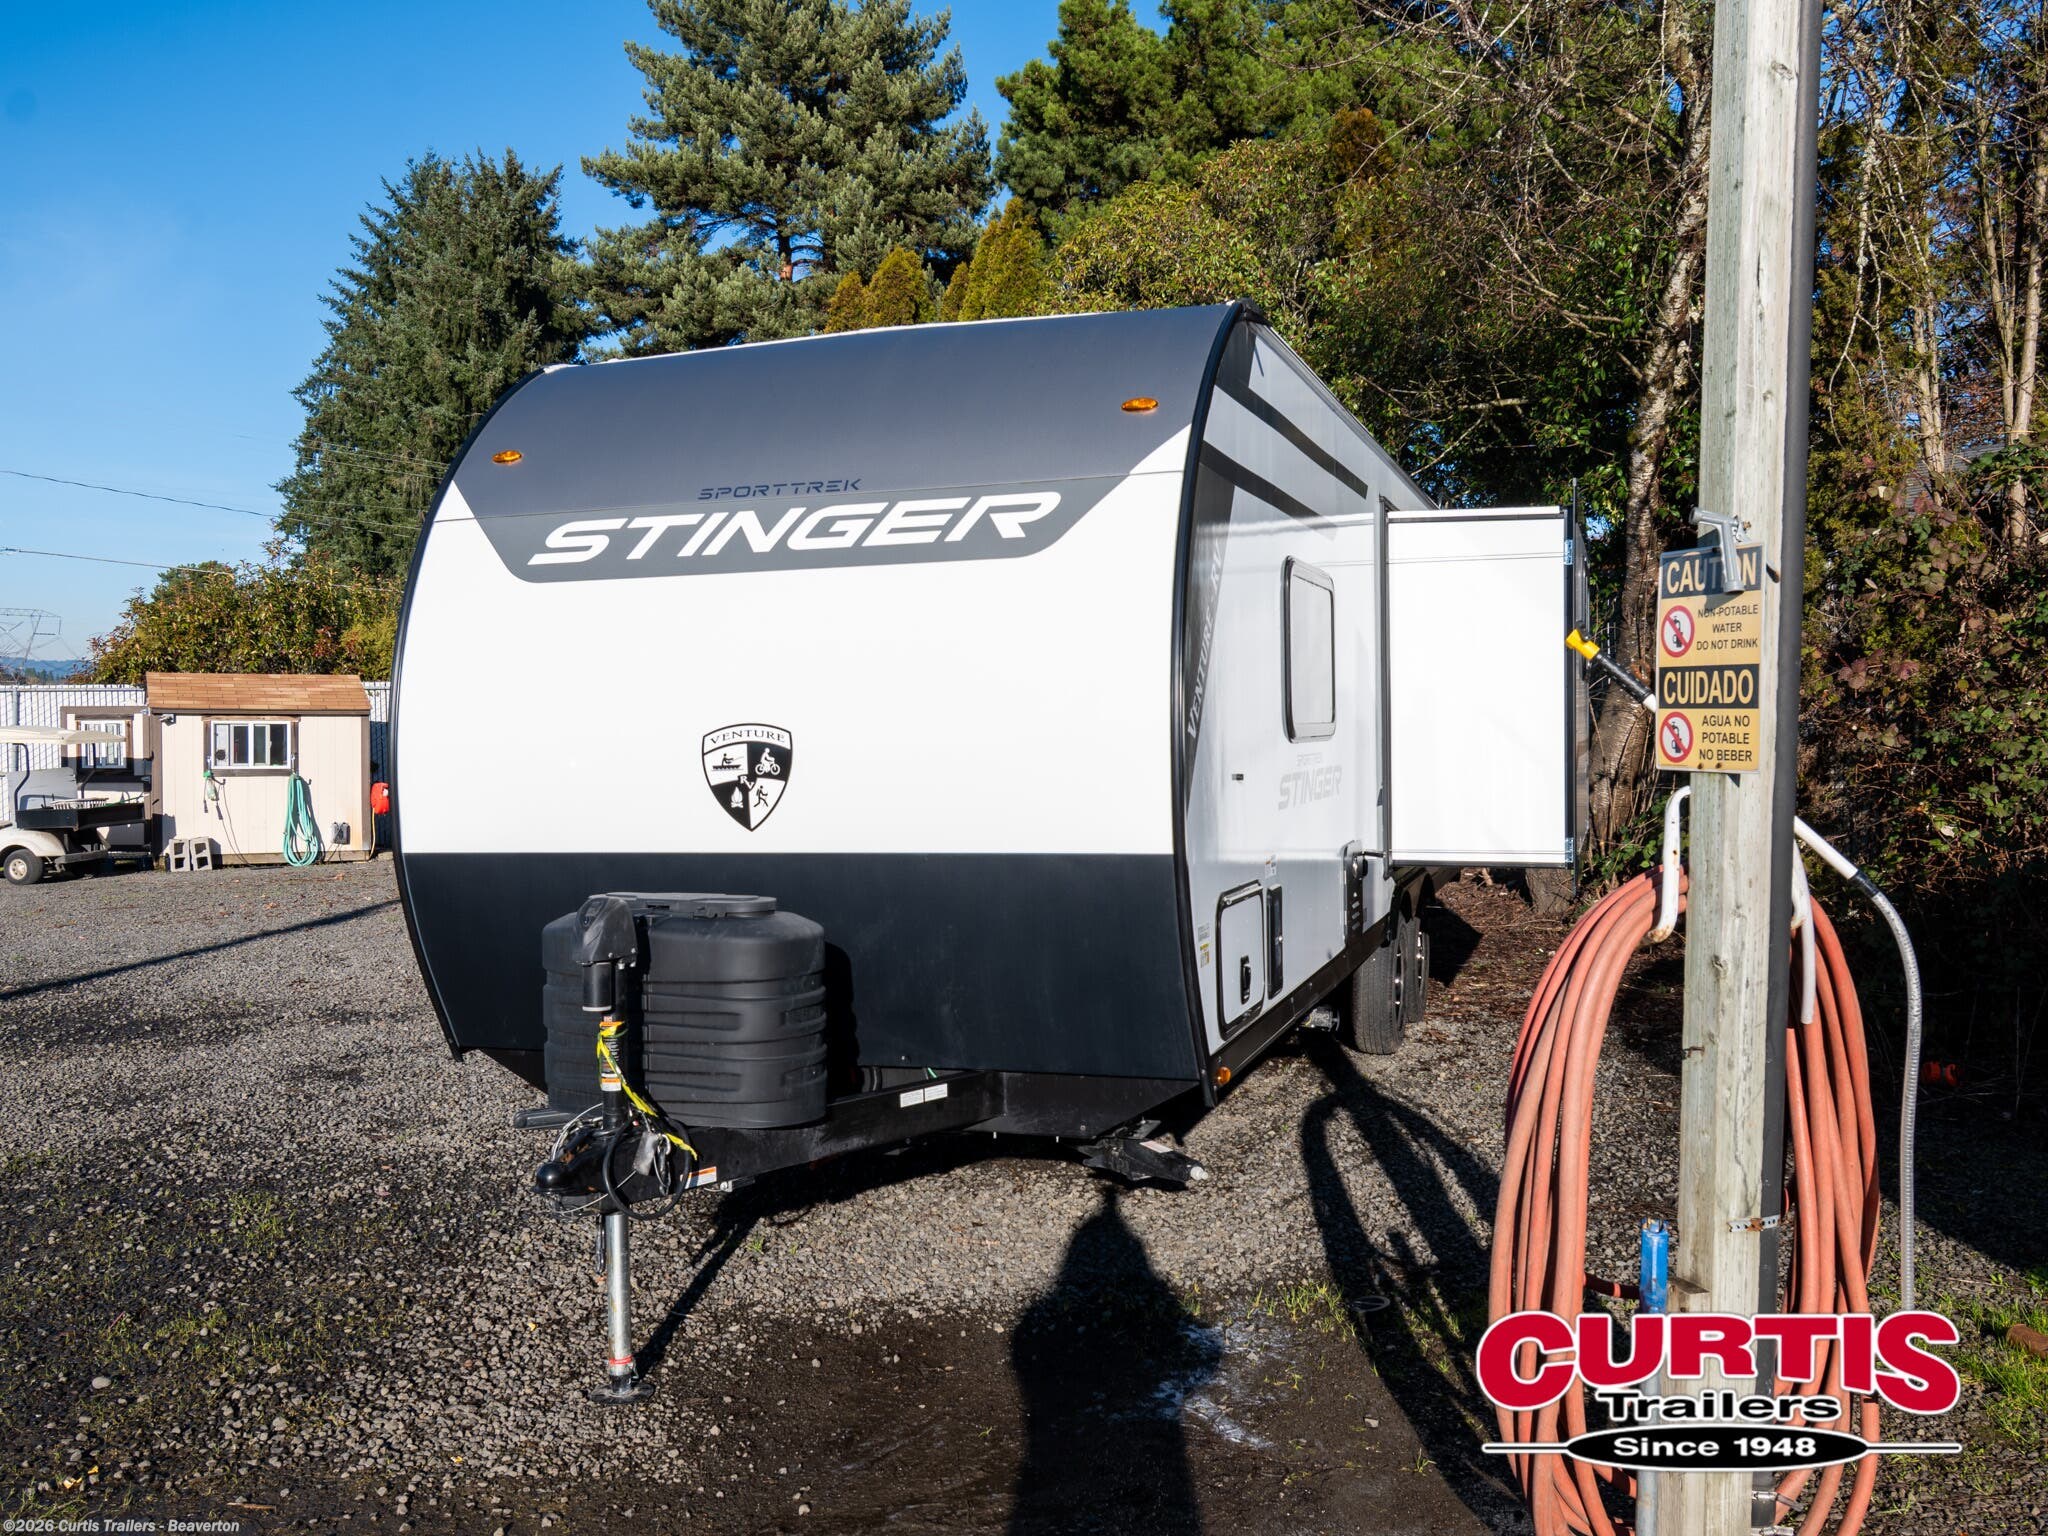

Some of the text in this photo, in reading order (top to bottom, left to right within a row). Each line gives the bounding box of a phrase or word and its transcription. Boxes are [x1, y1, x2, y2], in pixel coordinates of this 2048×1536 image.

[697, 478, 862, 501] SPORTTREK
[527, 491, 1062, 566] STINGER
[1667, 552, 1757, 594] CAUTN
[1698, 604, 1758, 618] NON-POTABLE
[1712, 623, 1742, 634] WATER
[1696, 638, 1758, 651] DO NOT DRINK
[1664, 669, 1754, 705] CUIDADO
[1701, 715, 1750, 728] AGUA NO
[710, 729, 786, 744] VENTURE
[1702, 732, 1750, 745] POTABLE
[1698, 749, 1752, 762] NO BEBER
[740, 775, 755, 790] RV
[1278, 766, 1343, 811] STINGER
